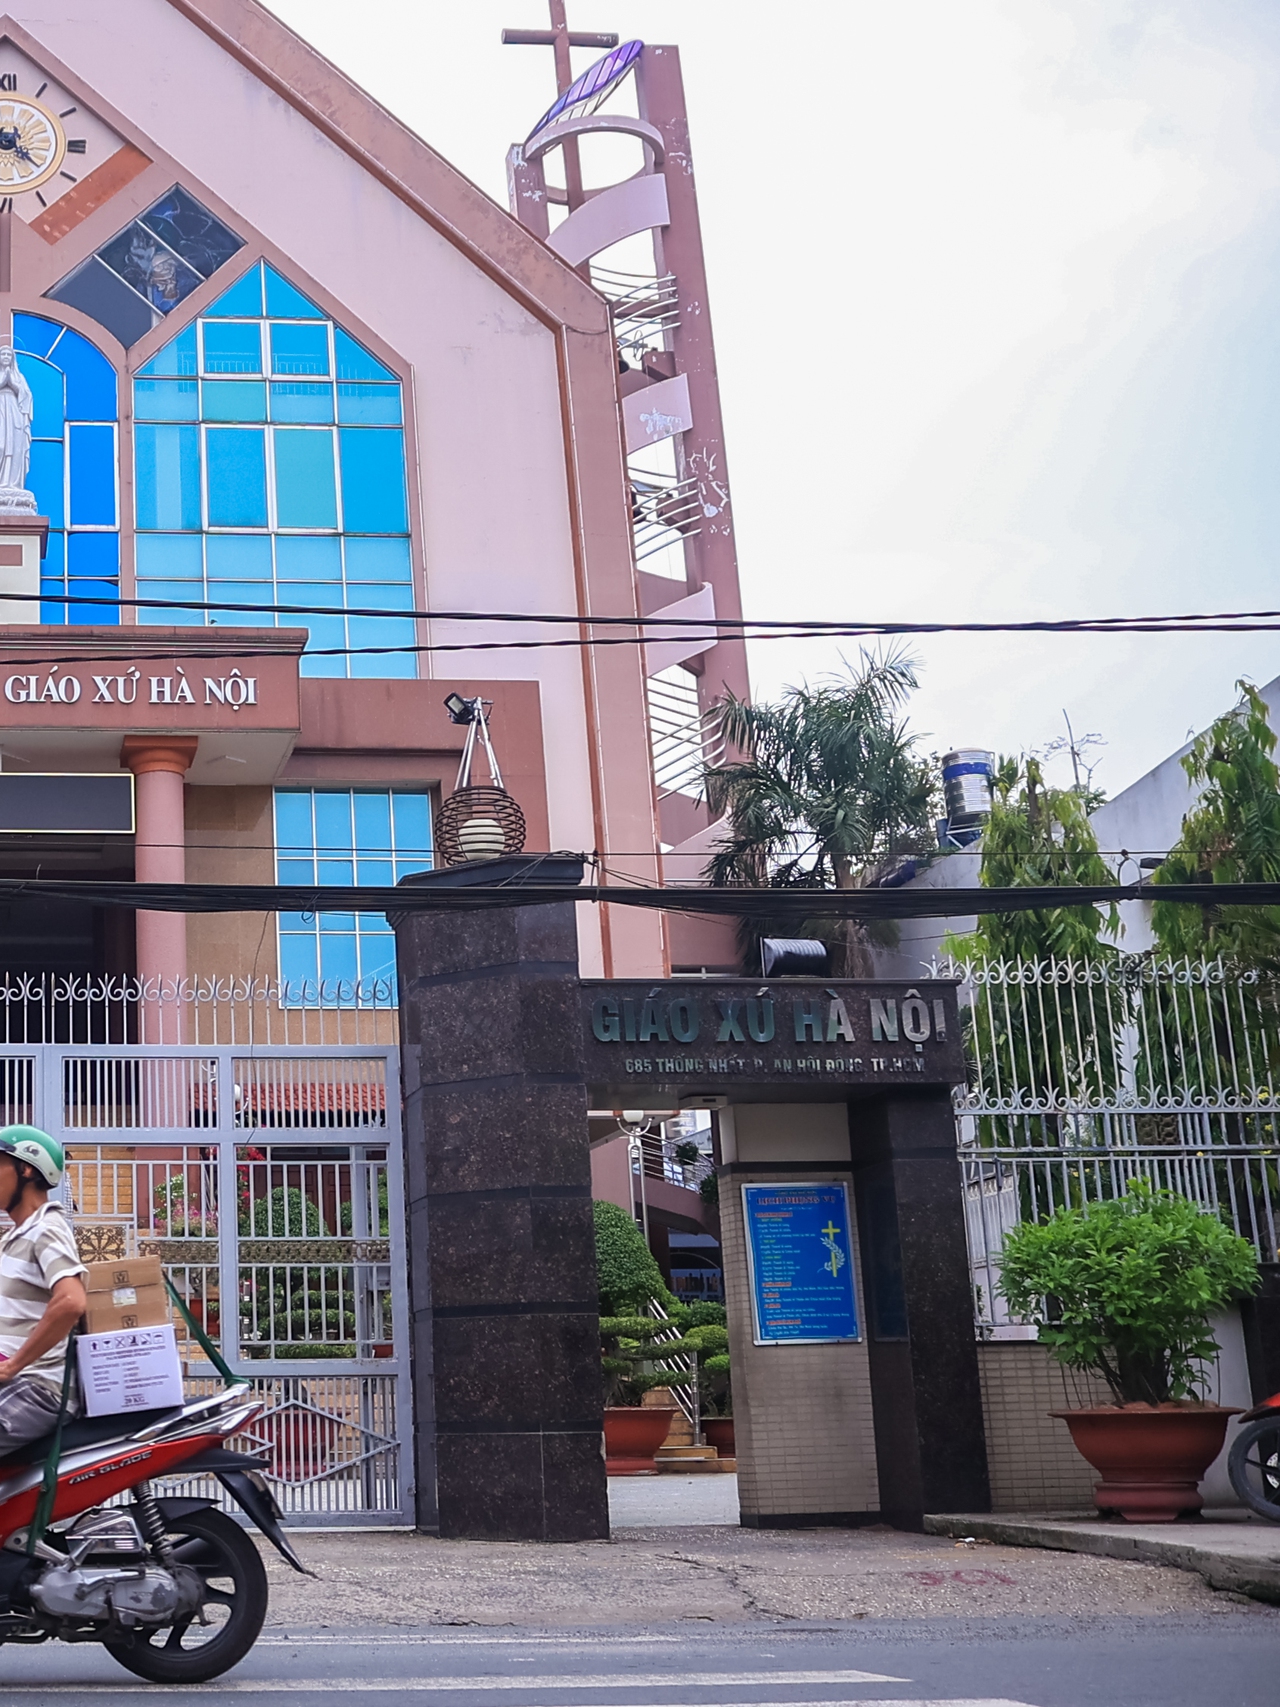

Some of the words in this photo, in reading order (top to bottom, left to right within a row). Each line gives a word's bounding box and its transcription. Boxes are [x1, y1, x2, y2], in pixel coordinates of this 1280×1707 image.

[4, 665, 82, 703] GIÁO
[91, 669, 142, 703] XỨ
[148, 666, 196, 703] HÀ
[204, 668, 258, 710] NỘI
[592, 987, 700, 1043] GIÁO
[716, 987, 775, 1043] XỨ
[793, 988, 856, 1043] HÀ
[871, 988, 947, 1053] NỘI
[625, 1058, 652, 1073] 685
[69, 1467, 97, 1485] AIR
[99, 1450, 153, 1475] BLADE
